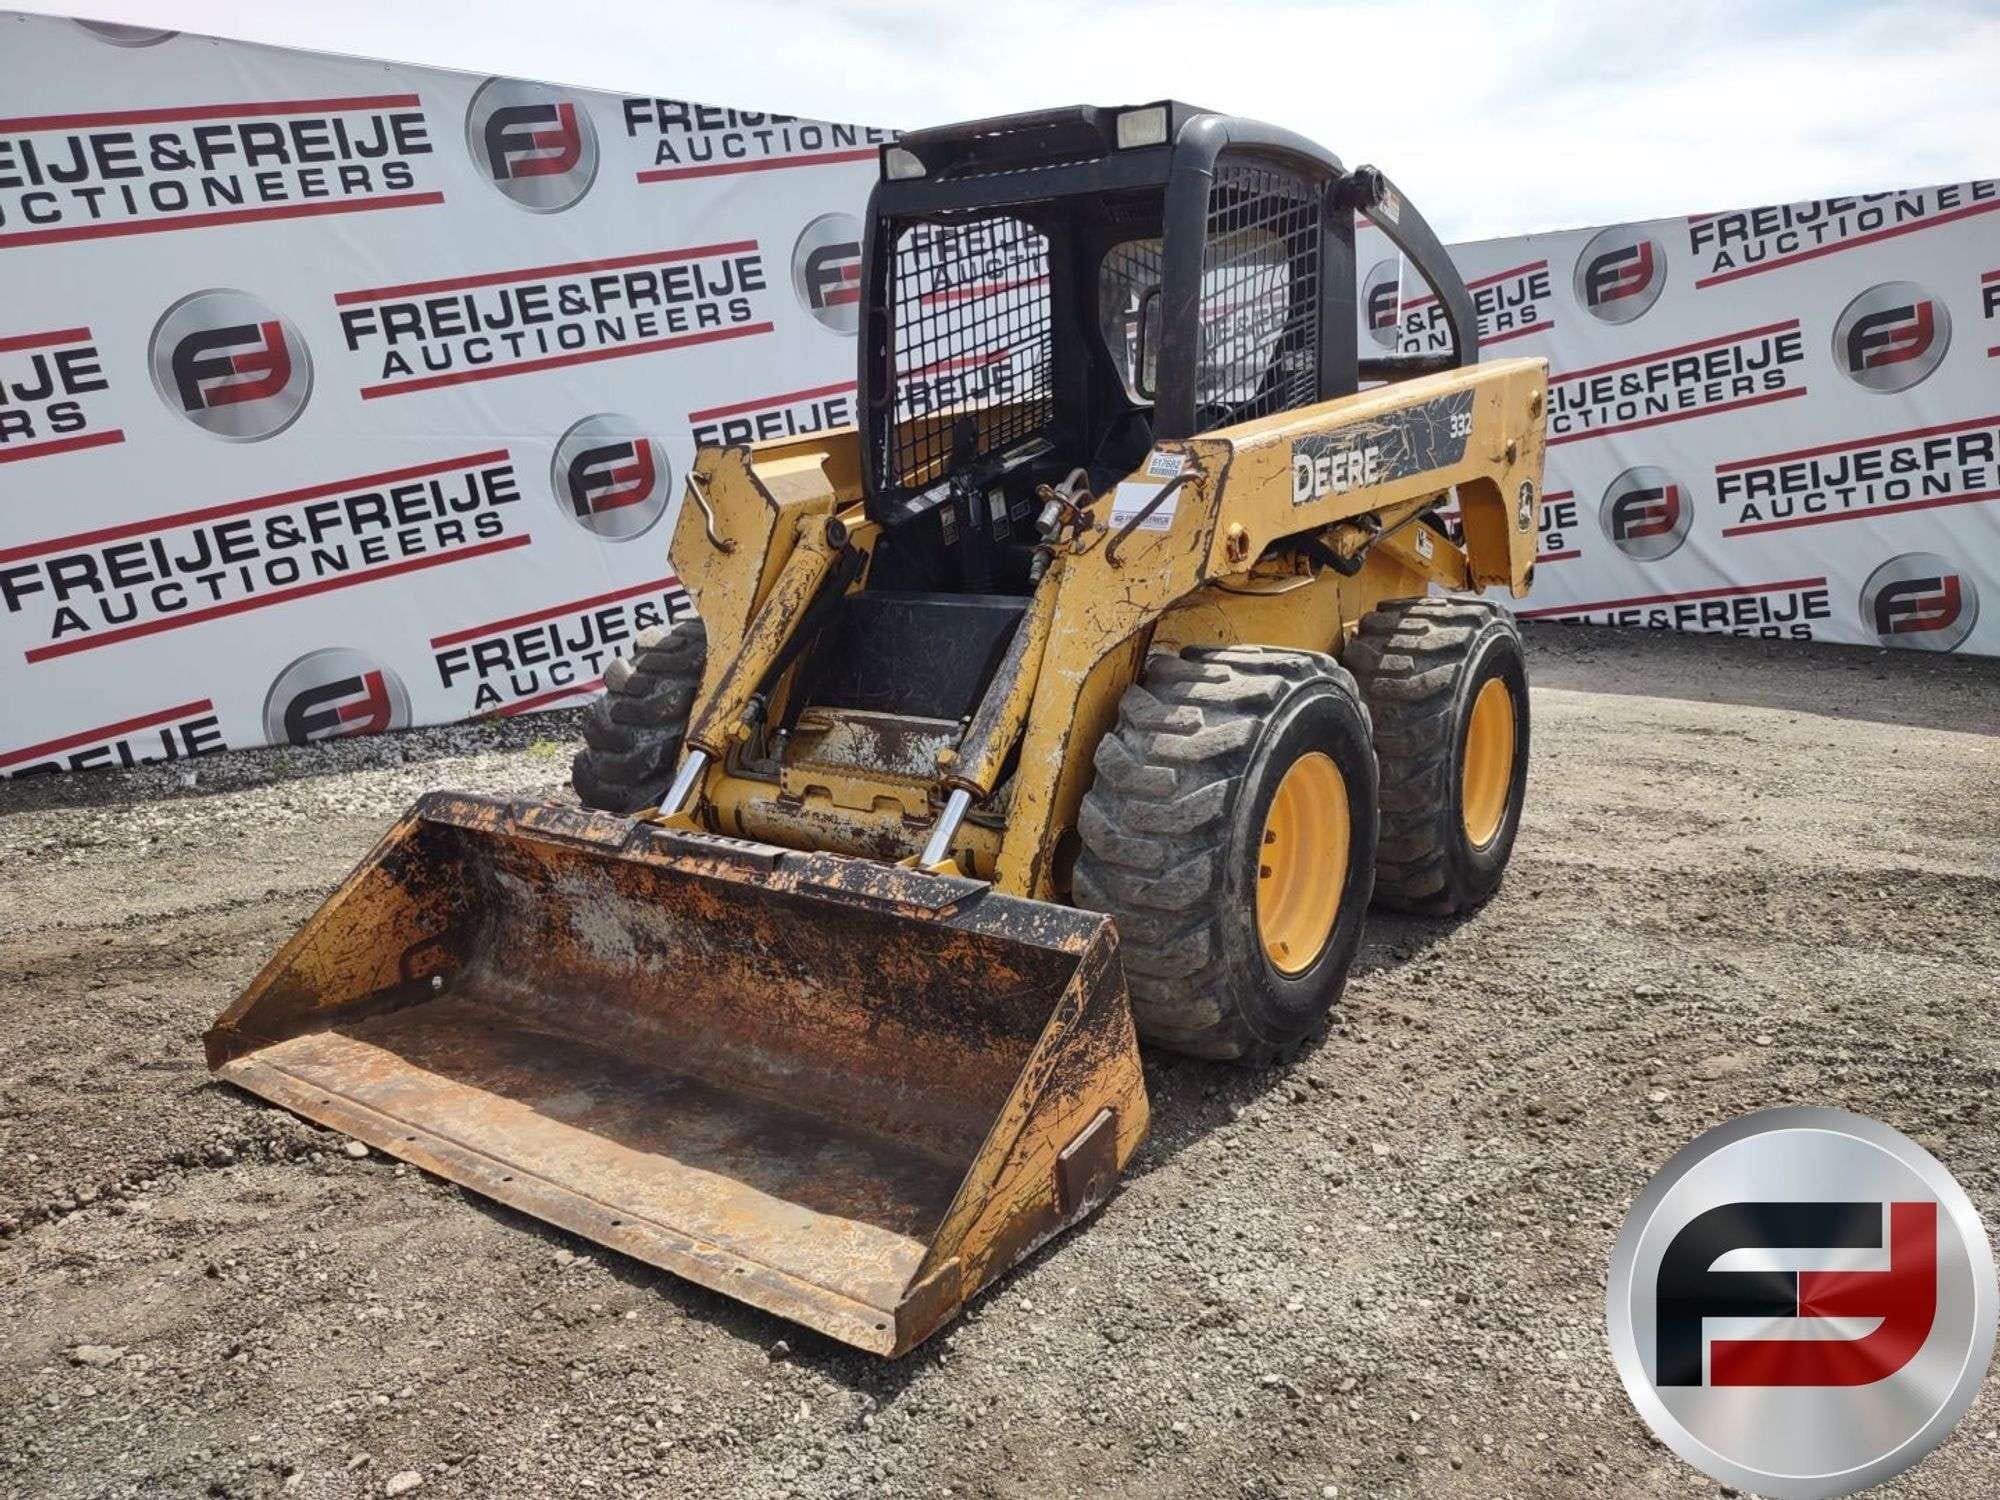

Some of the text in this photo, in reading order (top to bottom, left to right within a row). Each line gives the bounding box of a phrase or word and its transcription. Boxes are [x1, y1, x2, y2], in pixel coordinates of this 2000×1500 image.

[0, 161, 414, 228] CTIONEERS
[340, 256, 767, 351] FREIJE&FREIJE
[382, 298, 752, 379] AUCTIONEERS
[1293, 446, 1380, 502] DEERE
[1717, 430, 2000, 503] FREIJE&FR
[1739, 465, 2000, 524] AUCTIONE
[51, 511, 504, 640] AUCTIONEERS
